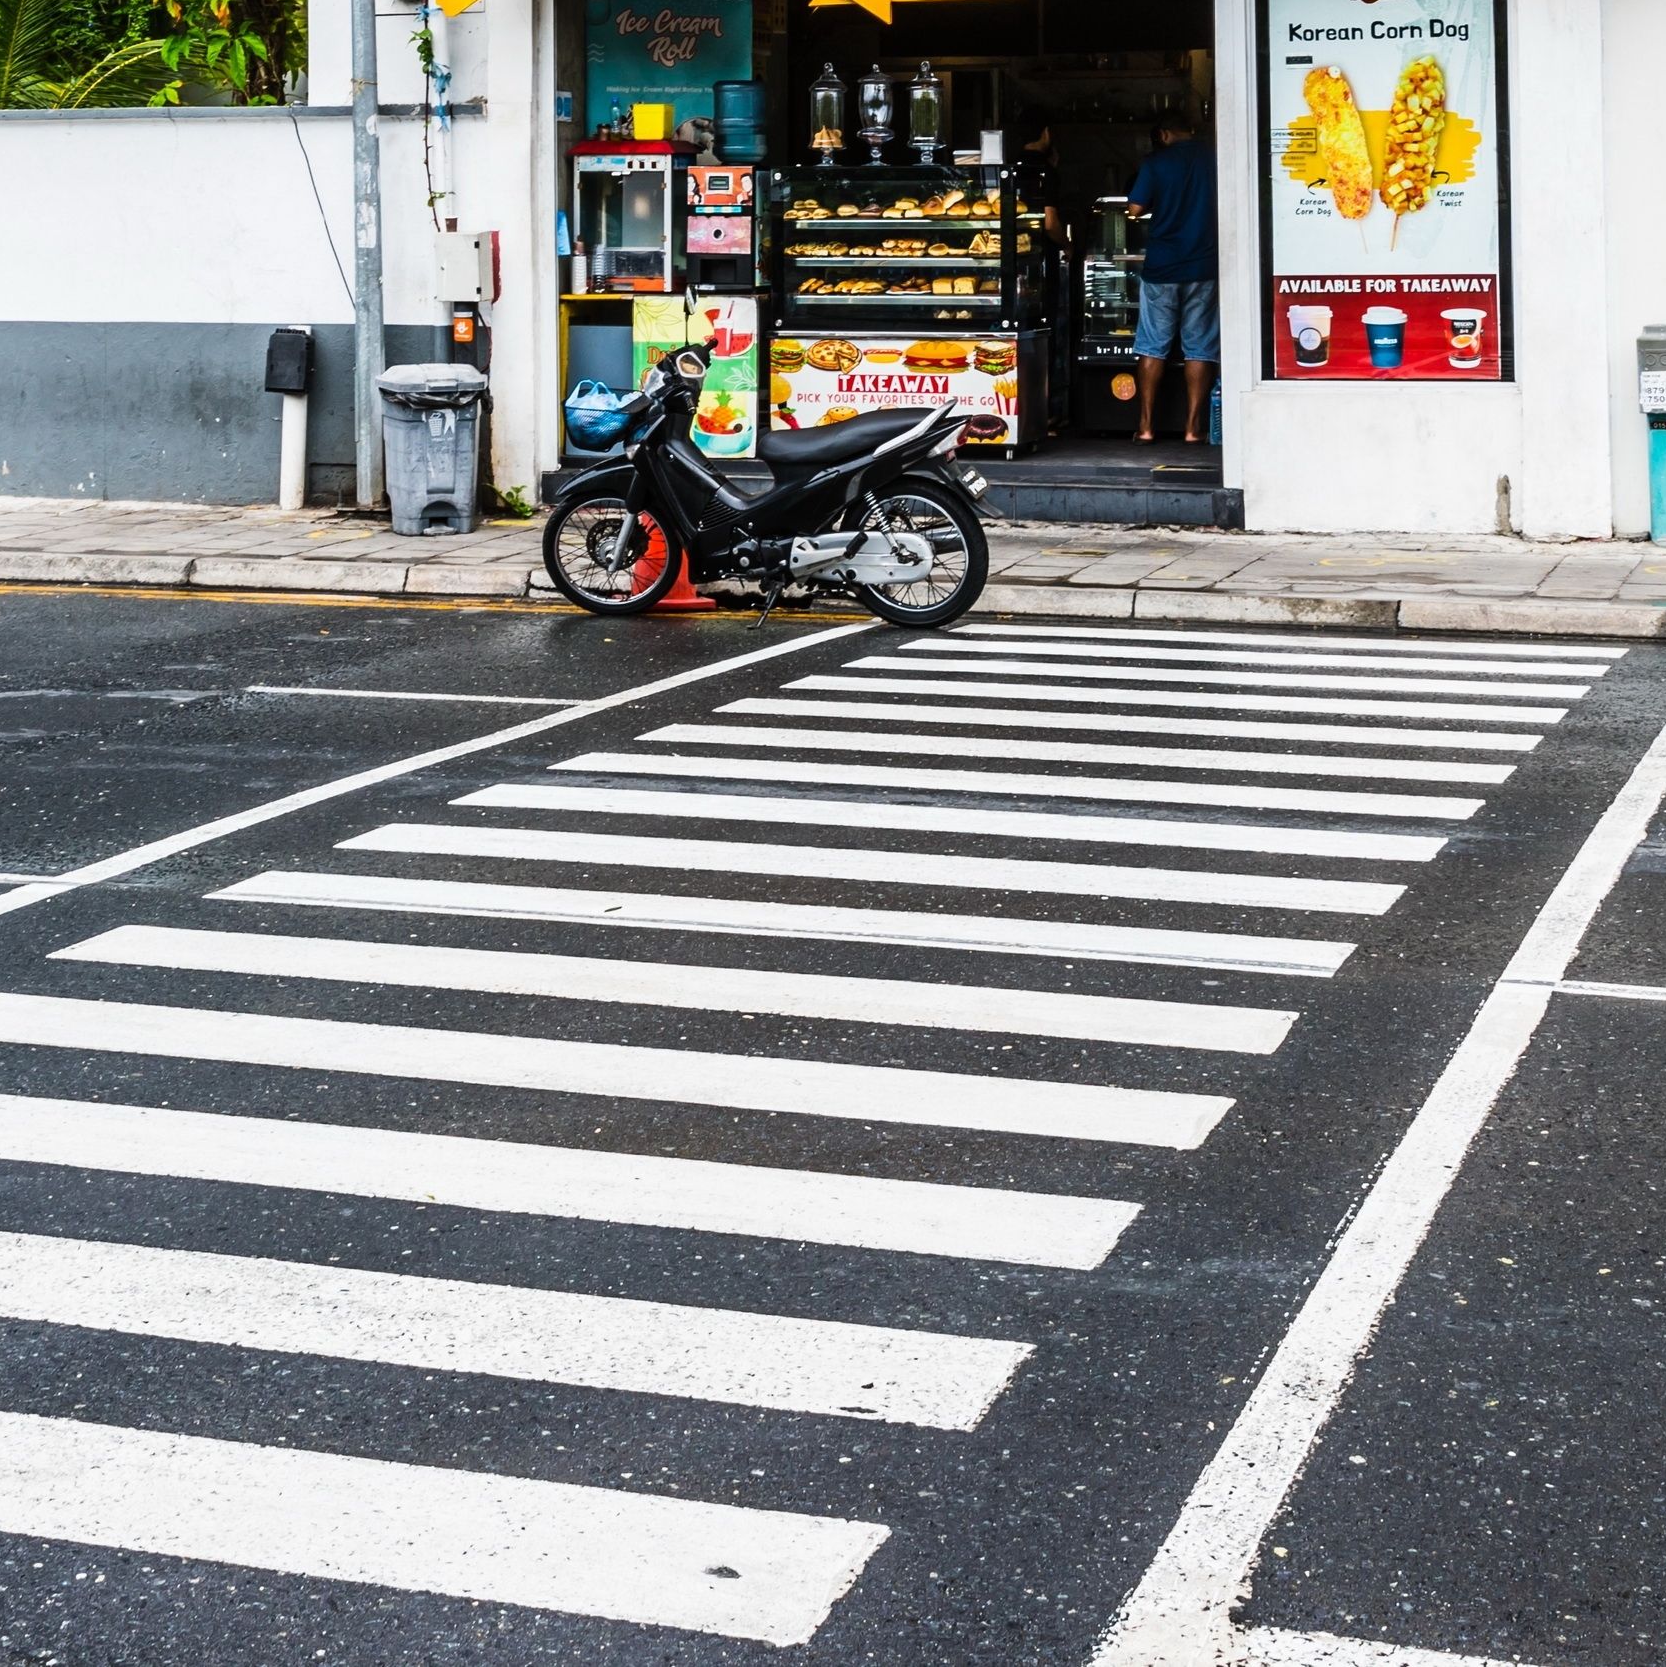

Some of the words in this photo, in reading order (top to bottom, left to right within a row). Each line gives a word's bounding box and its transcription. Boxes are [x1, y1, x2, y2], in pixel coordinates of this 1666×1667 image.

[616, 9, 650, 35] Ice
[653, 9, 723, 37] Cream
[1288, 23, 1363, 42] Korean
[1370, 20, 1422, 40] Corn
[1428, 19, 1470, 41] Dog
[647, 36, 697, 67] Roll
[1439, 199, 1462, 207] Twist
[1295, 207, 1314, 216] Corn
[1317, 207, 1332, 217] Dog
[1279, 279, 1361, 294] AVAILABLE
[1365, 279, 1397, 293] FOR
[1400, 278, 1492, 293] TAKEAWAY
[839, 375, 947, 393] TAKEAWAY
[797, 393, 821, 403] PICK
[827, 393, 856, 404] YOUR
[862, 394, 925, 405] FAVORITES
[930, 395, 946, 405] ON
[979, 396, 996, 406] GO
